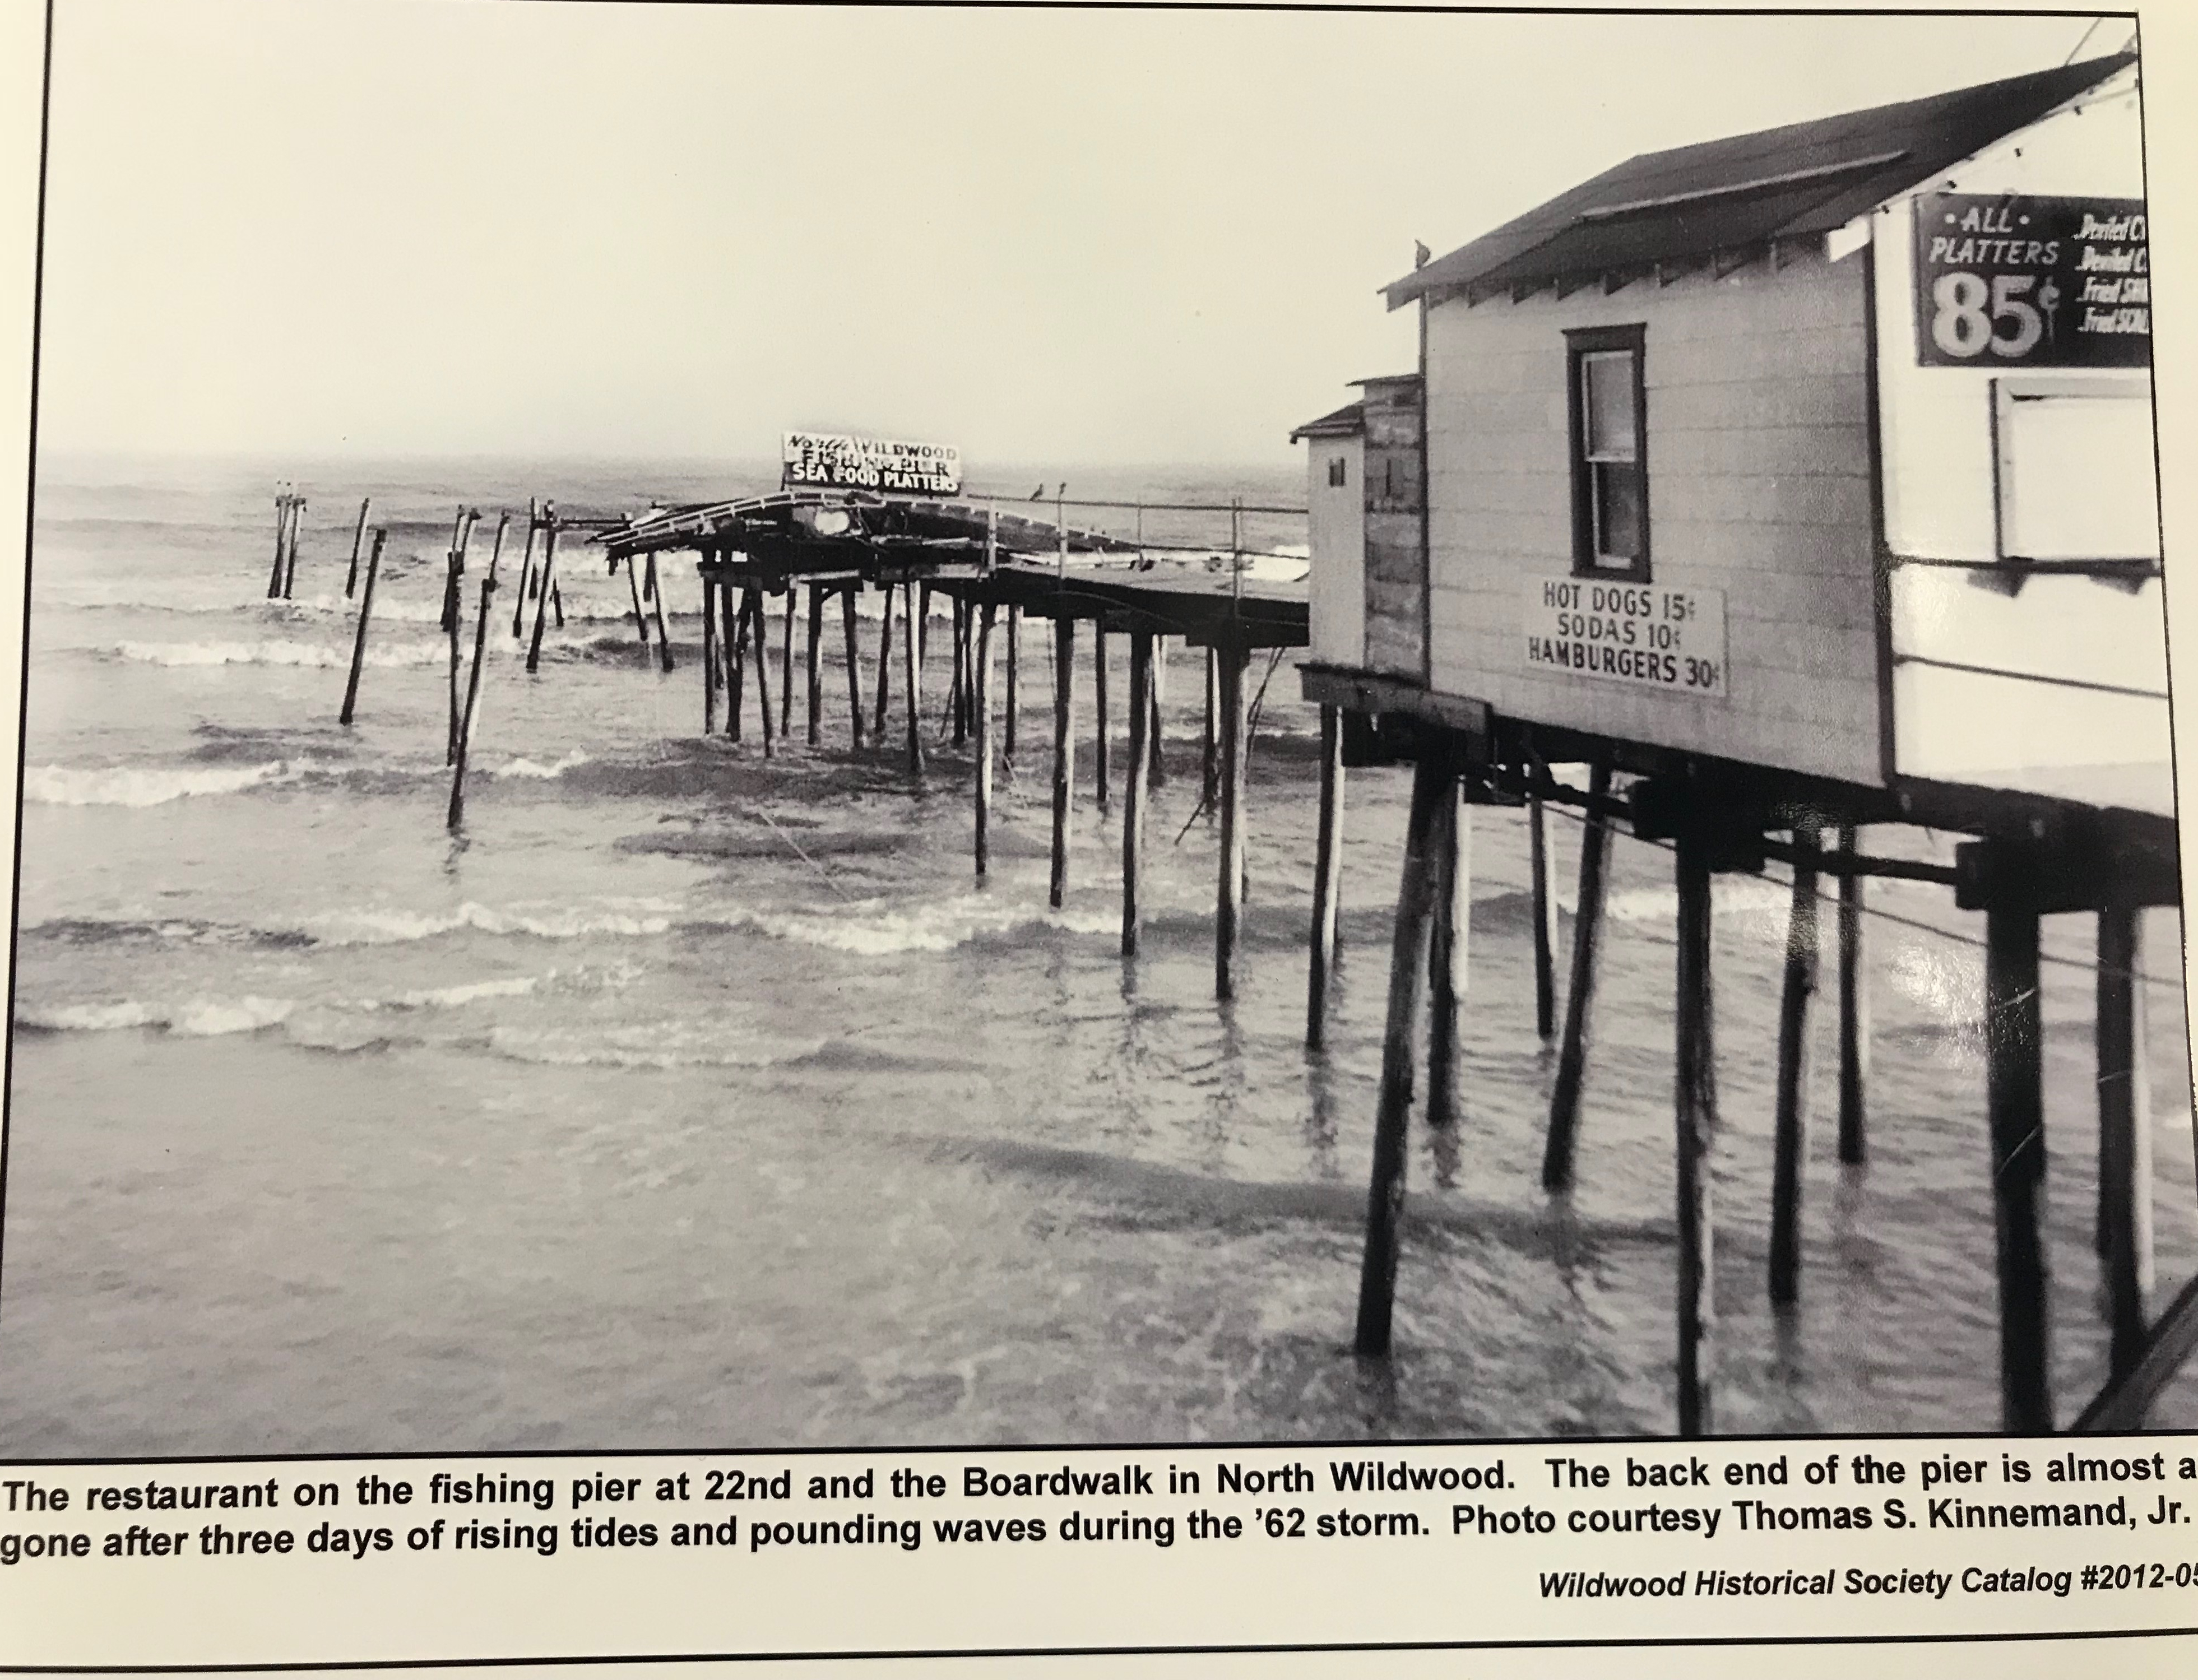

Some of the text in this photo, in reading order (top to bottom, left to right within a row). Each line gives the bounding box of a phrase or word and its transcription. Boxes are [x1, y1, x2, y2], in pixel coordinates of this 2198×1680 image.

[1961, 207, 2014, 233] ALL
[1928, 236, 2061, 265] PLATTERS
[1932, 271, 2061, 358] 85¢
[791, 462, 828, 482] SEA
[833, 467, 880, 486] FOOD
[1543, 581, 1582, 610] HOT
[1592, 586, 1652, 617] DOGS
[1557, 611, 1636, 645] SODAS
[1529, 636, 1677, 683] HAMBURGERS
[2, 1481, 69, 1511] The
[86, 1478, 279, 1511] restaurant
[294, 1483, 339, 1506] on
[356, 1474, 413, 1505] the
[429, 1472, 554, 1510] fishing
[572, 1471, 642, 1510] pier
[655, 1472, 690, 1501] at
[704, 1469, 791, 1500] 22nd
[808, 1468, 873, 1500] and
[890, 1468, 946, 1498] the
[964, 1464, 1153, 1497] Boardwalk
[1169, 1464, 1200, 1494] in
[1218, 1463, 1314, 1496] North
[1329, 1459, 1514, 1492] Wildwood.
[1545, 1458, 1610, 1488] The
[1626, 1456, 1710, 1487] back
[1724, 1455, 1788, 1486] end
[1804, 1454, 1839, 1485] of
[1851, 1454, 1905, 1484] the
[1921, 1453, 1988, 1492] pier
[2002, 1452, 2032, 1483] is
[2047, 1452, 2165, 1482] almost
[0, 1534, 91, 1565] gone
[103, 1525, 189, 1557] after
[200, 1524, 295, 1555] three
[307, 1521, 393, 1560] days
[407, 1519, 446, 1551] of
[455, 1518, 558, 1556] rising
[571, 1516, 659, 1548] tides
[671, 1515, 737, 1546] and
[750, 1513, 921, 1553] pounding
[933, 1519, 1047, 1543] waves
[1059, 1510, 1175, 1548] during
[1186, 1509, 1242, 1539] the
[1316, 1507, 1429, 1537] storm.
[1453, 1504, 1556, 1535] Photo
[1568, 1503, 1721, 1539] courtesy
[1732, 1500, 1872, 1530] Thomas
[1884, 1498, 1916, 1529] S.
[1928, 1496, 2136, 1531] Kinnemand,
[2147, 1495, 2190, 1525] Jr.
[1539, 1571, 1686, 1598] Wildwood
[1694, 1568, 1835, 1596] Historical
[1844, 1567, 1953, 1600] Society
[1961, 1566, 2072, 1598] Catalog
